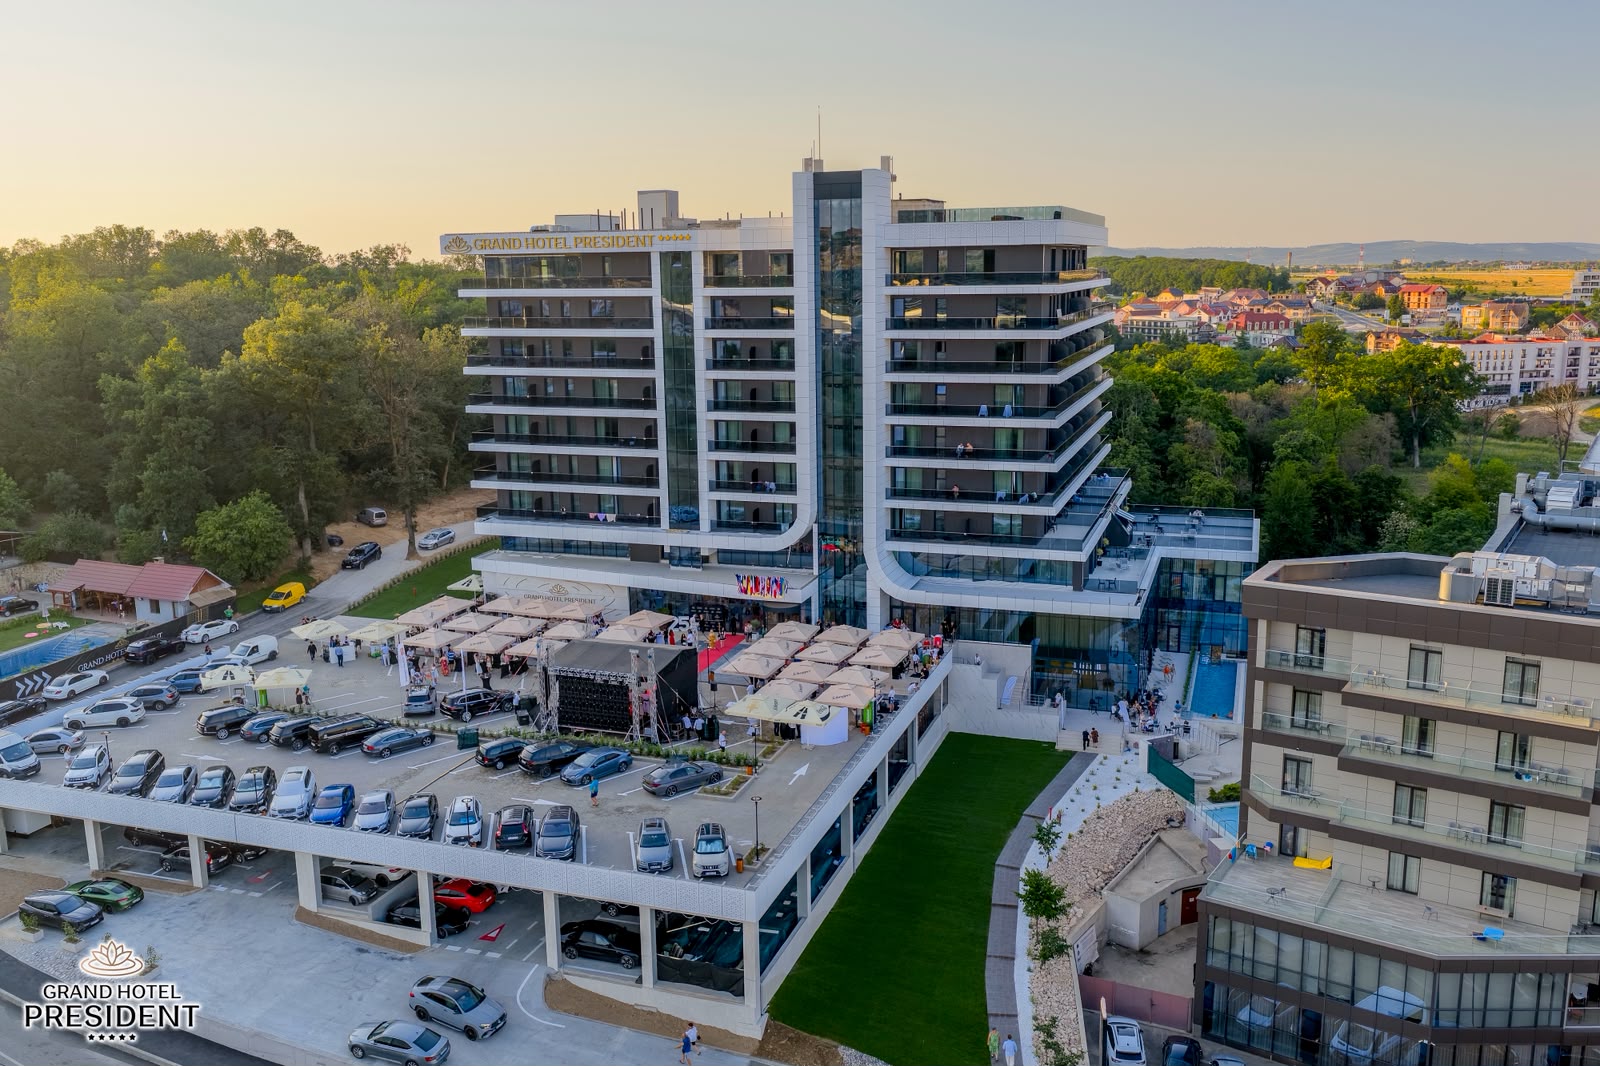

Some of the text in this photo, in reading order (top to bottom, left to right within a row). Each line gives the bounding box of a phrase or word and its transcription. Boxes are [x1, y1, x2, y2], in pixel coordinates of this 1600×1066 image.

[473, 234, 655, 251] GRAND HOTEL PRESIDENT
[669, 616, 690, 632] 25
[78, 648, 127, 672] GRAND HOTE
